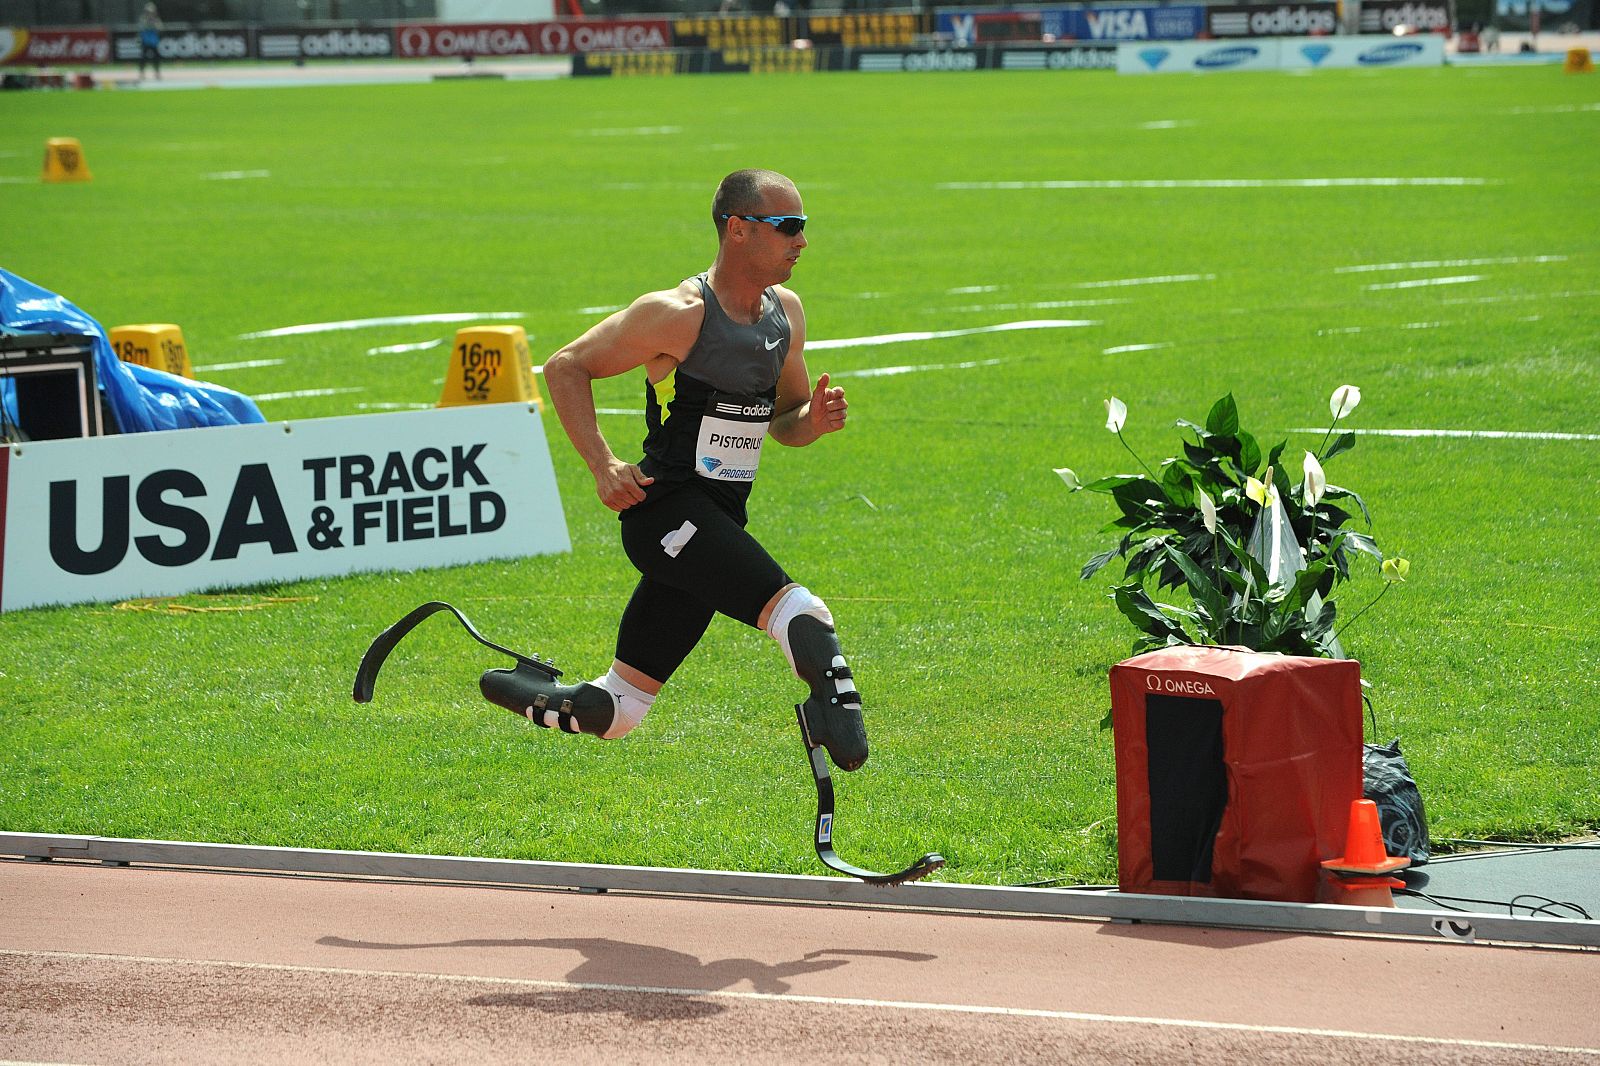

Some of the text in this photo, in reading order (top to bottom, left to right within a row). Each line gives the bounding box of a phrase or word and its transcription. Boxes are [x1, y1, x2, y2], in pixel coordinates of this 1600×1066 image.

[1086, 10, 1149, 38] VISA
[1251, 7, 1336, 34] adidas
[158, 32, 246, 58] adidas
[301, 29, 391, 56] adidas
[435, 29, 530, 53] OMEGA
[573, 25, 665, 50] OMEGA
[904, 50, 977, 71] adidas
[458, 343, 502, 367] 16m
[743, 404, 771, 416] adidas
[709, 433, 763, 450] PISTORIU
[303, 443, 489, 501] TRACK
[49, 463, 298, 575] USA
[307, 491, 507, 551] & FIELD
[1165, 679, 1216, 695] OMEGA
